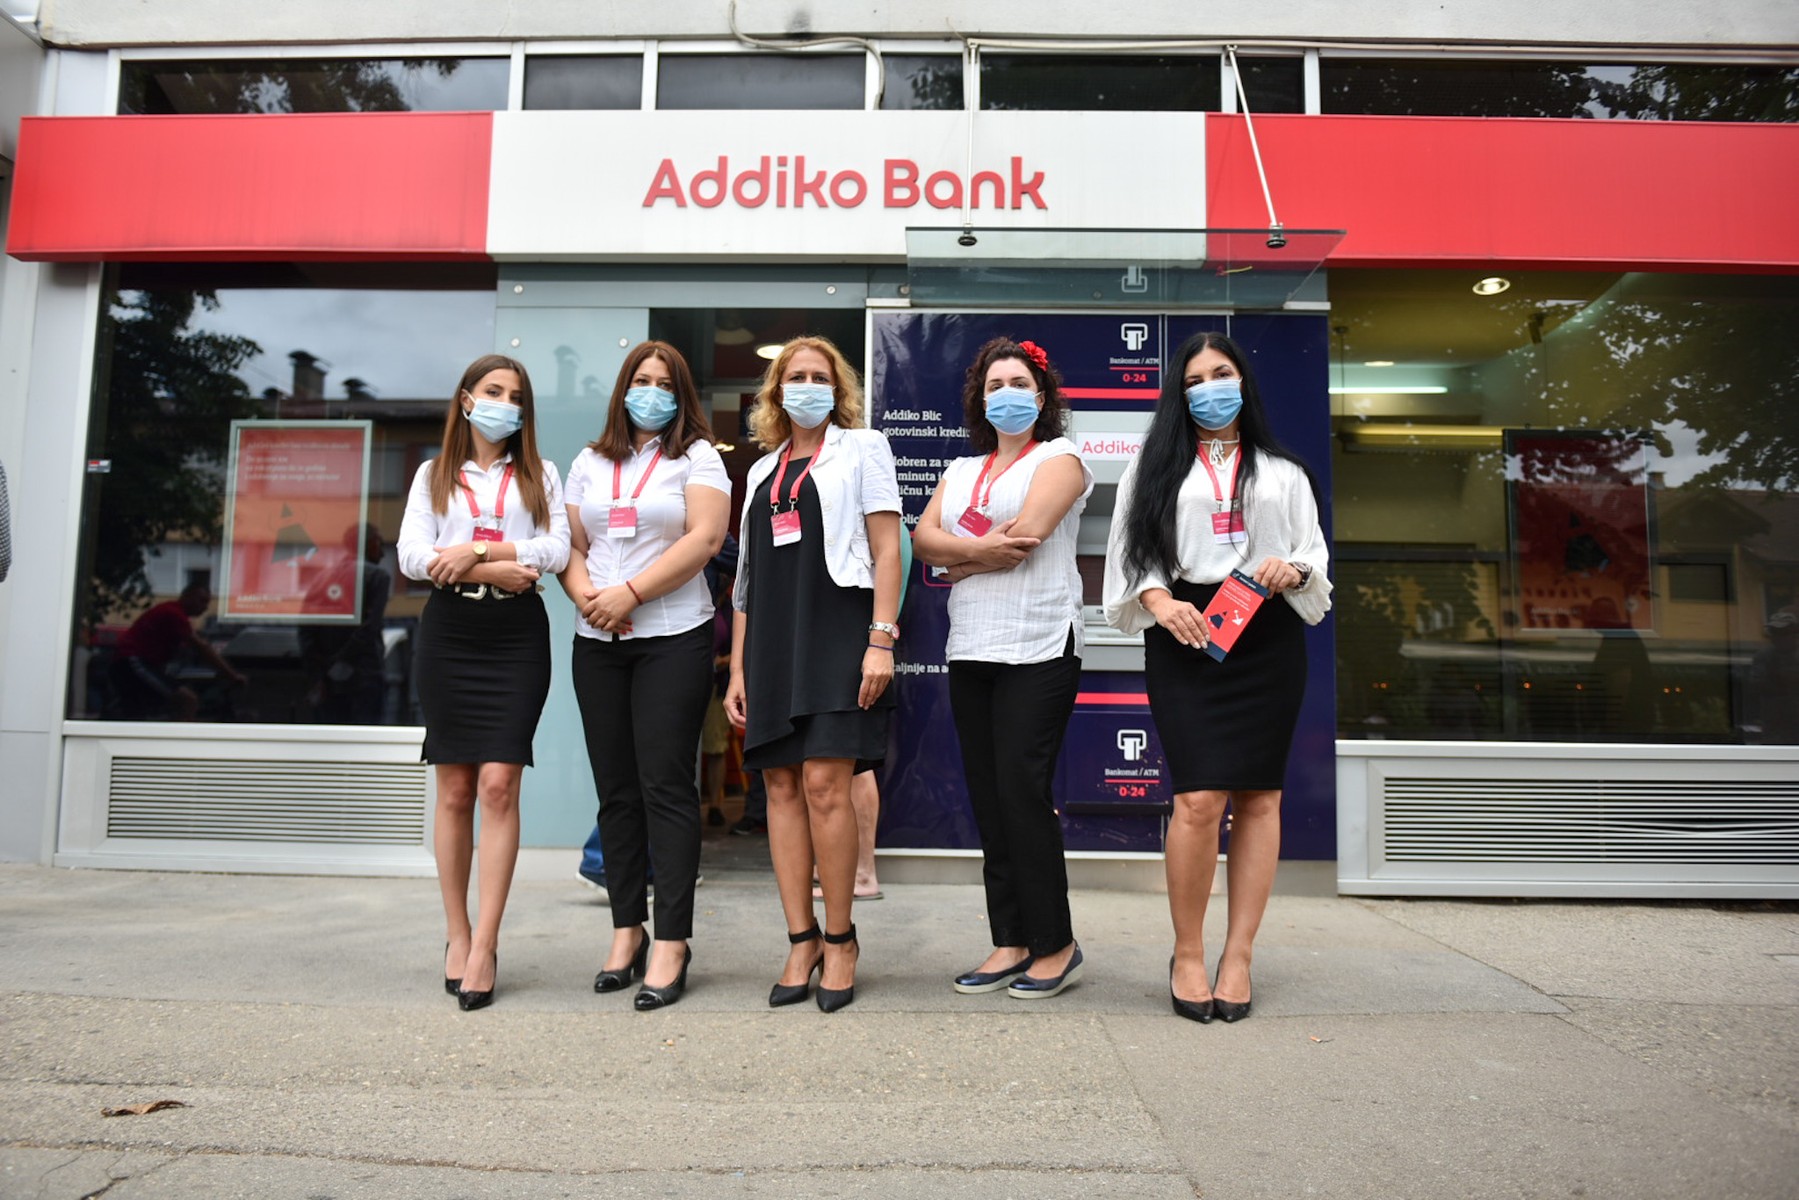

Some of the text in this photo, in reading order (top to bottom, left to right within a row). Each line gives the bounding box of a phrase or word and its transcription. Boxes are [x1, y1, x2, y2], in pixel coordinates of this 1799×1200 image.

[642, 155, 1049, 211] Addiko Bank
[1123, 373, 1147, 383] 0-24
[882, 409, 942, 421] Addiko Blic
[882, 426, 938, 438] gotovinski
[929, 459, 942, 467] za
[897, 471, 937, 481] minuta
[926, 664, 940, 673] na
[1104, 768, 1138, 776] Bankomat
[1143, 768, 1159, 776] ATM
[1119, 786, 1146, 797] 0-24
